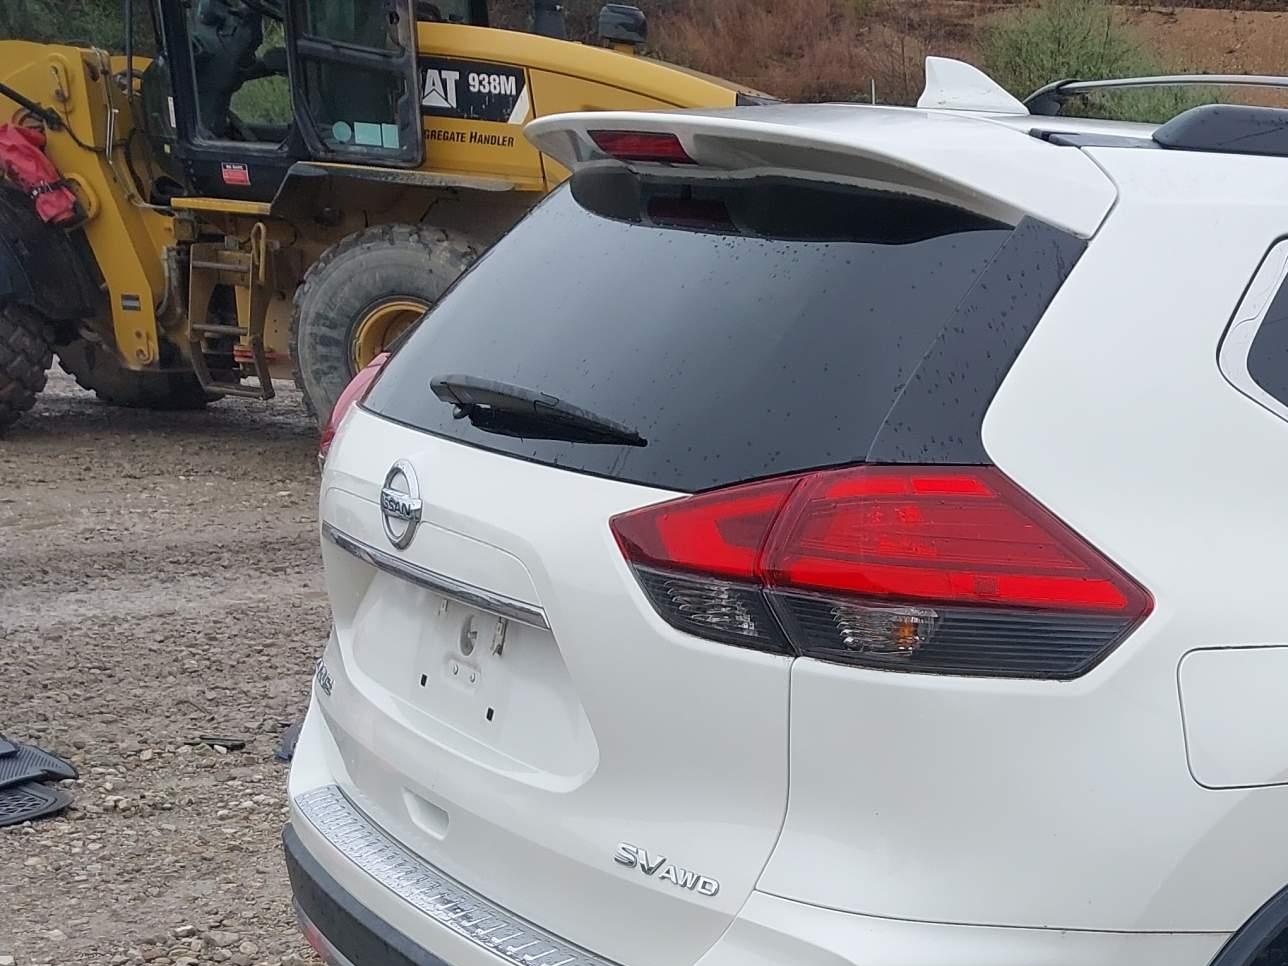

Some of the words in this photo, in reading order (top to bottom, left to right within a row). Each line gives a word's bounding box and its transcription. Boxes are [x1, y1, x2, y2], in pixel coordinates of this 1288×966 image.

[422, 68, 460, 109] AT
[468, 72, 517, 96] 938M
[423, 128, 467, 143] GREGATE
[614, 841, 667, 876] SV
[659, 864, 720, 897] AWD
